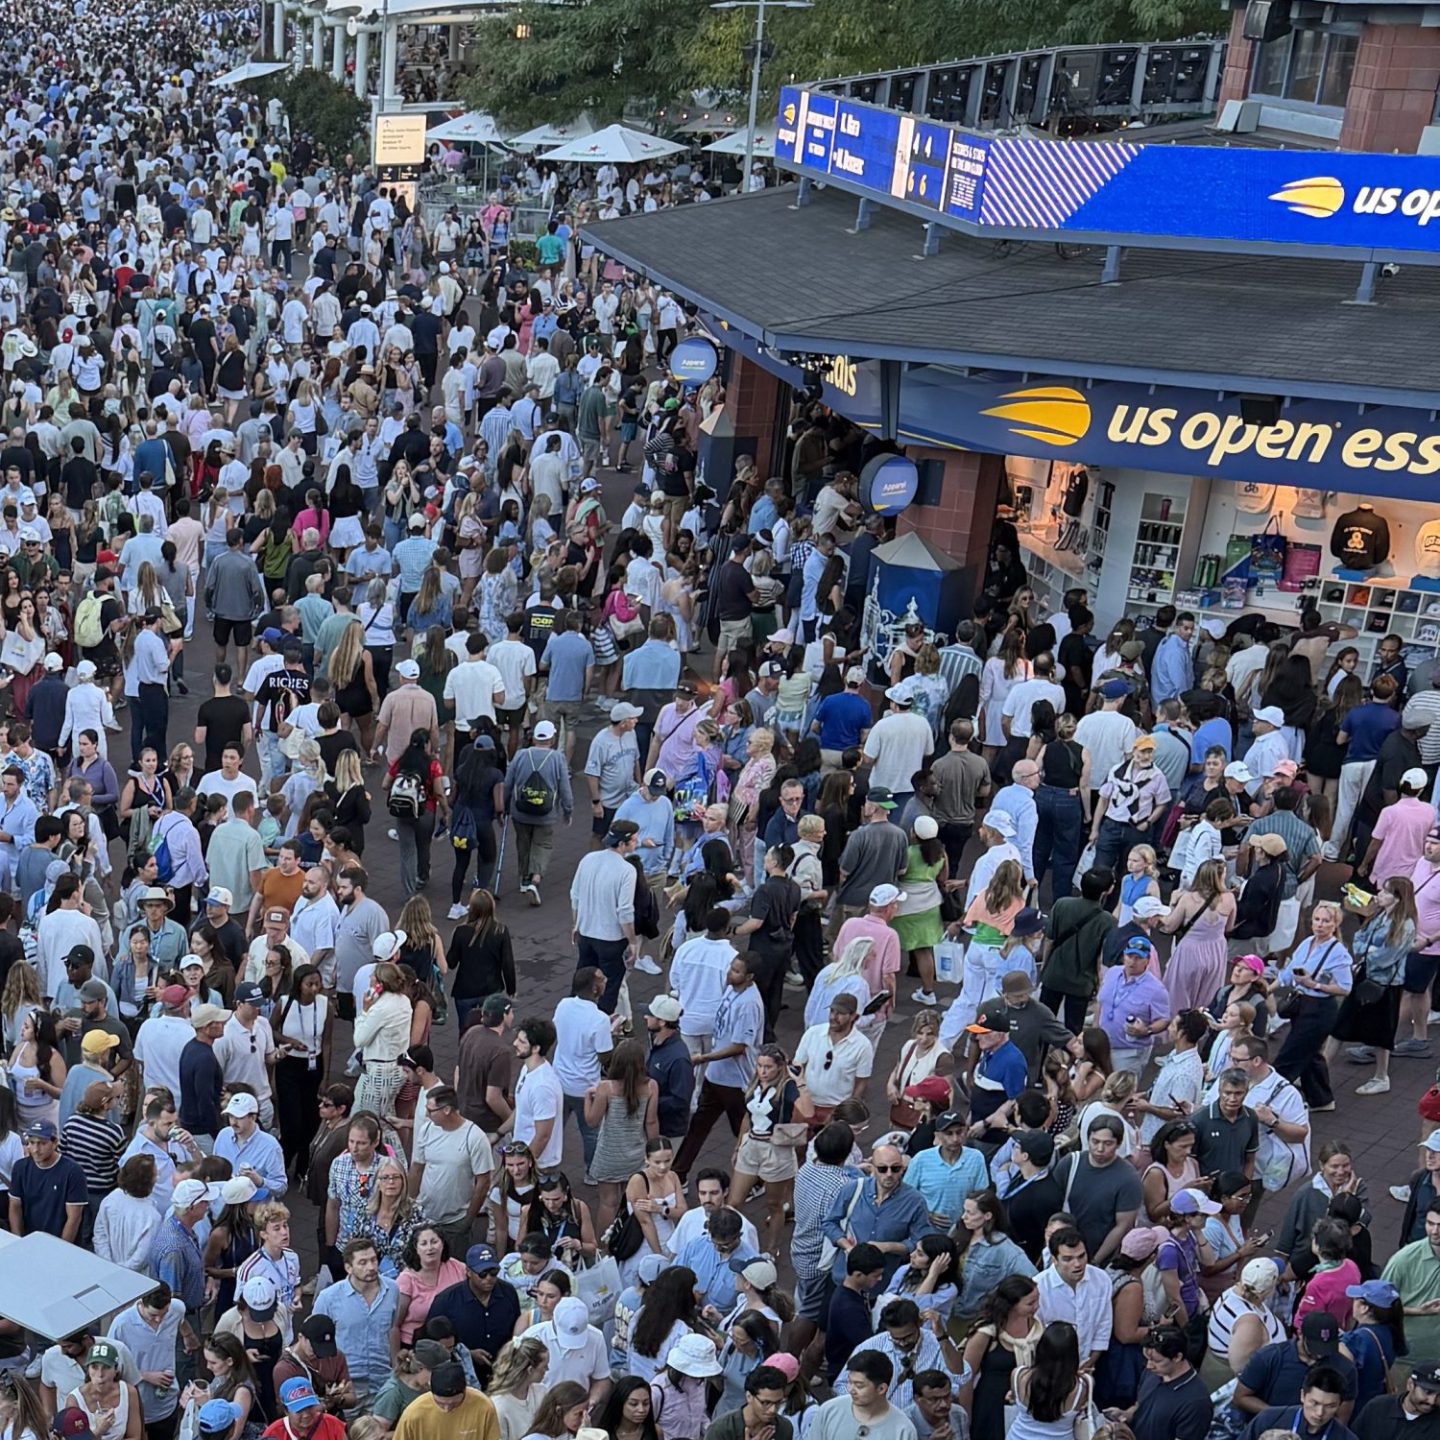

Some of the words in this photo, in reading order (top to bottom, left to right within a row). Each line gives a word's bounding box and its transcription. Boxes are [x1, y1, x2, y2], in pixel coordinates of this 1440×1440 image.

[919, 174, 927, 196] 6
[1353, 187, 1402, 214] us
[1107, 404, 1178, 447] us
[1180, 411, 1334, 466] open
[269, 677, 310, 690] RICHES
[92, 1345, 109, 1357] 26
